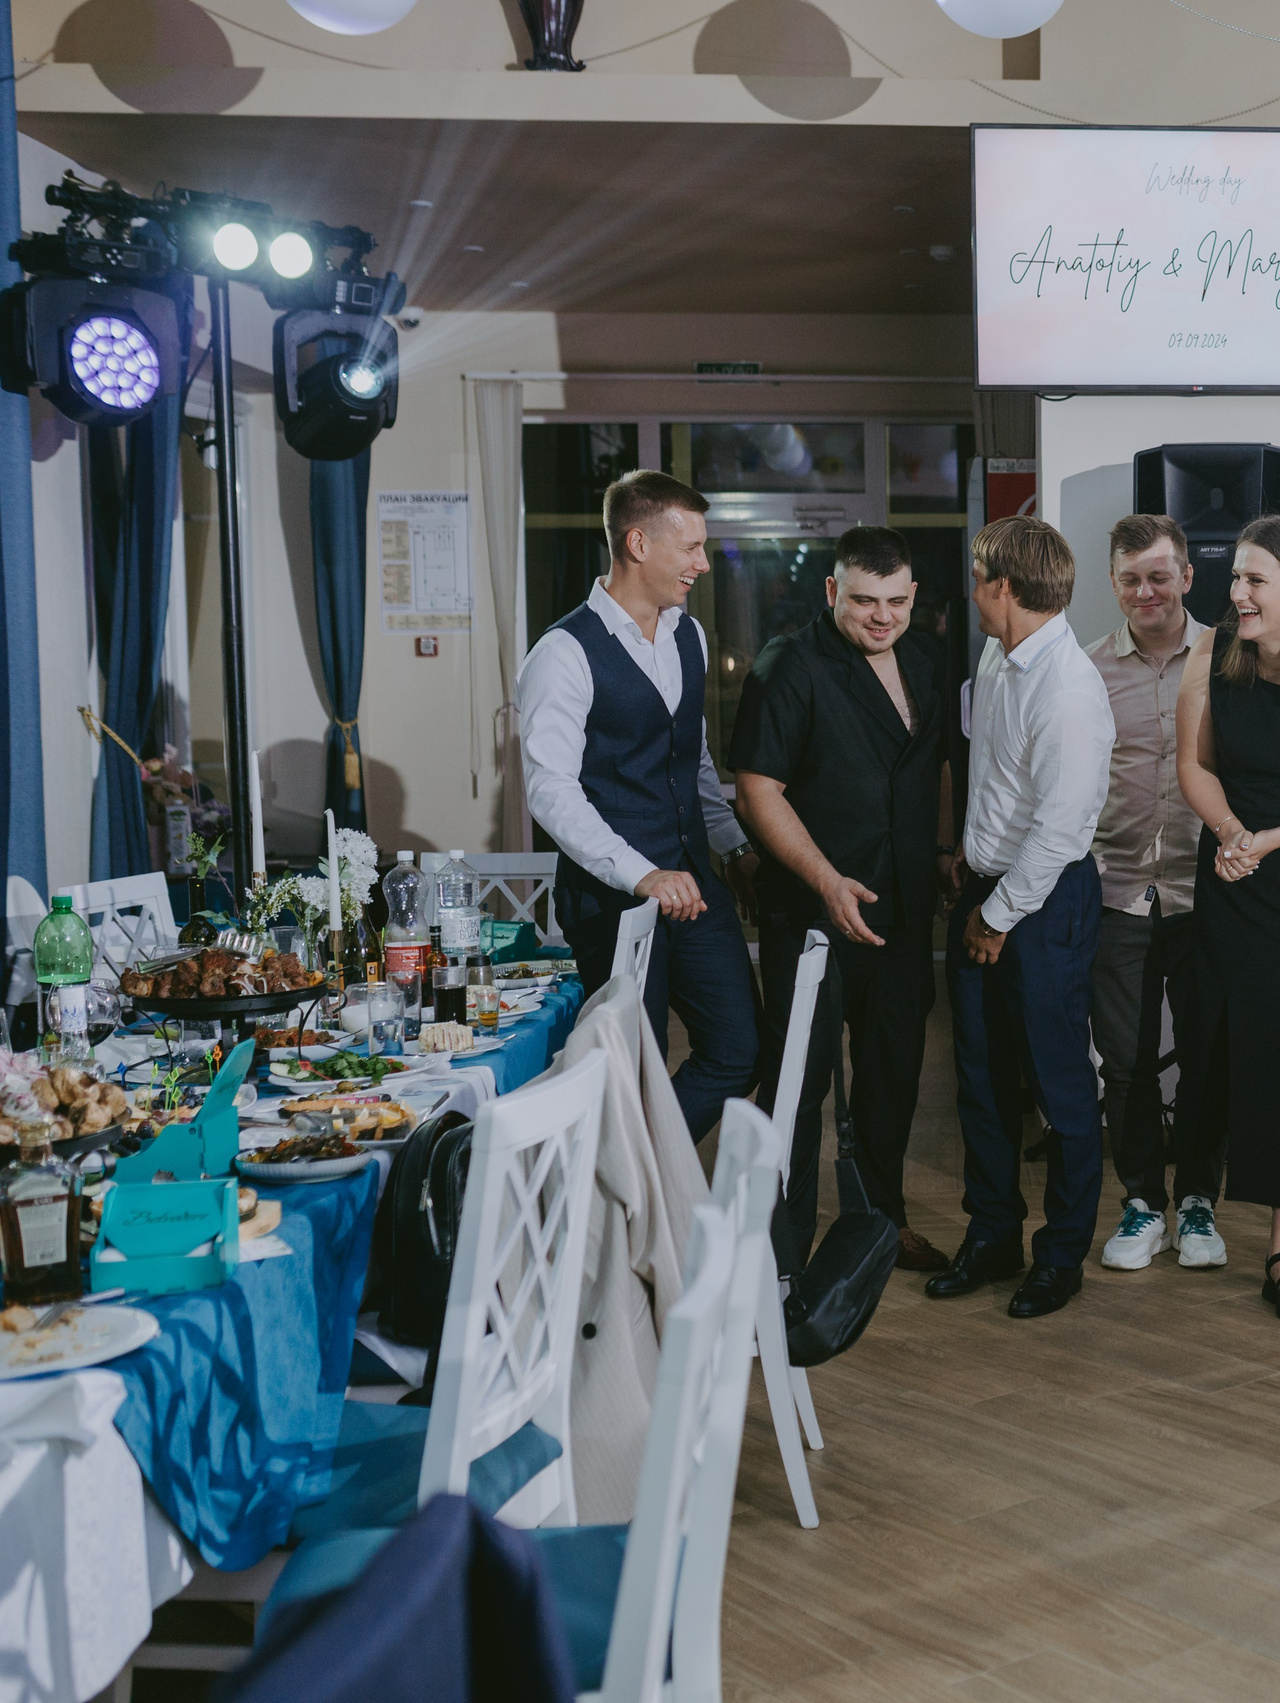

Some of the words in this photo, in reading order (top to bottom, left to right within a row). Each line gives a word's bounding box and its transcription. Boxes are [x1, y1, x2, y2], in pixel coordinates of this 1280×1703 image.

[1145, 162, 1215, 203] Wedding
[1219, 166, 1246, 205] day
[1163, 248, 1183, 278] &
[379, 494, 407, 503] ПЛАН
[409, 494, 468, 504] ЭВАКУАЦИИ
